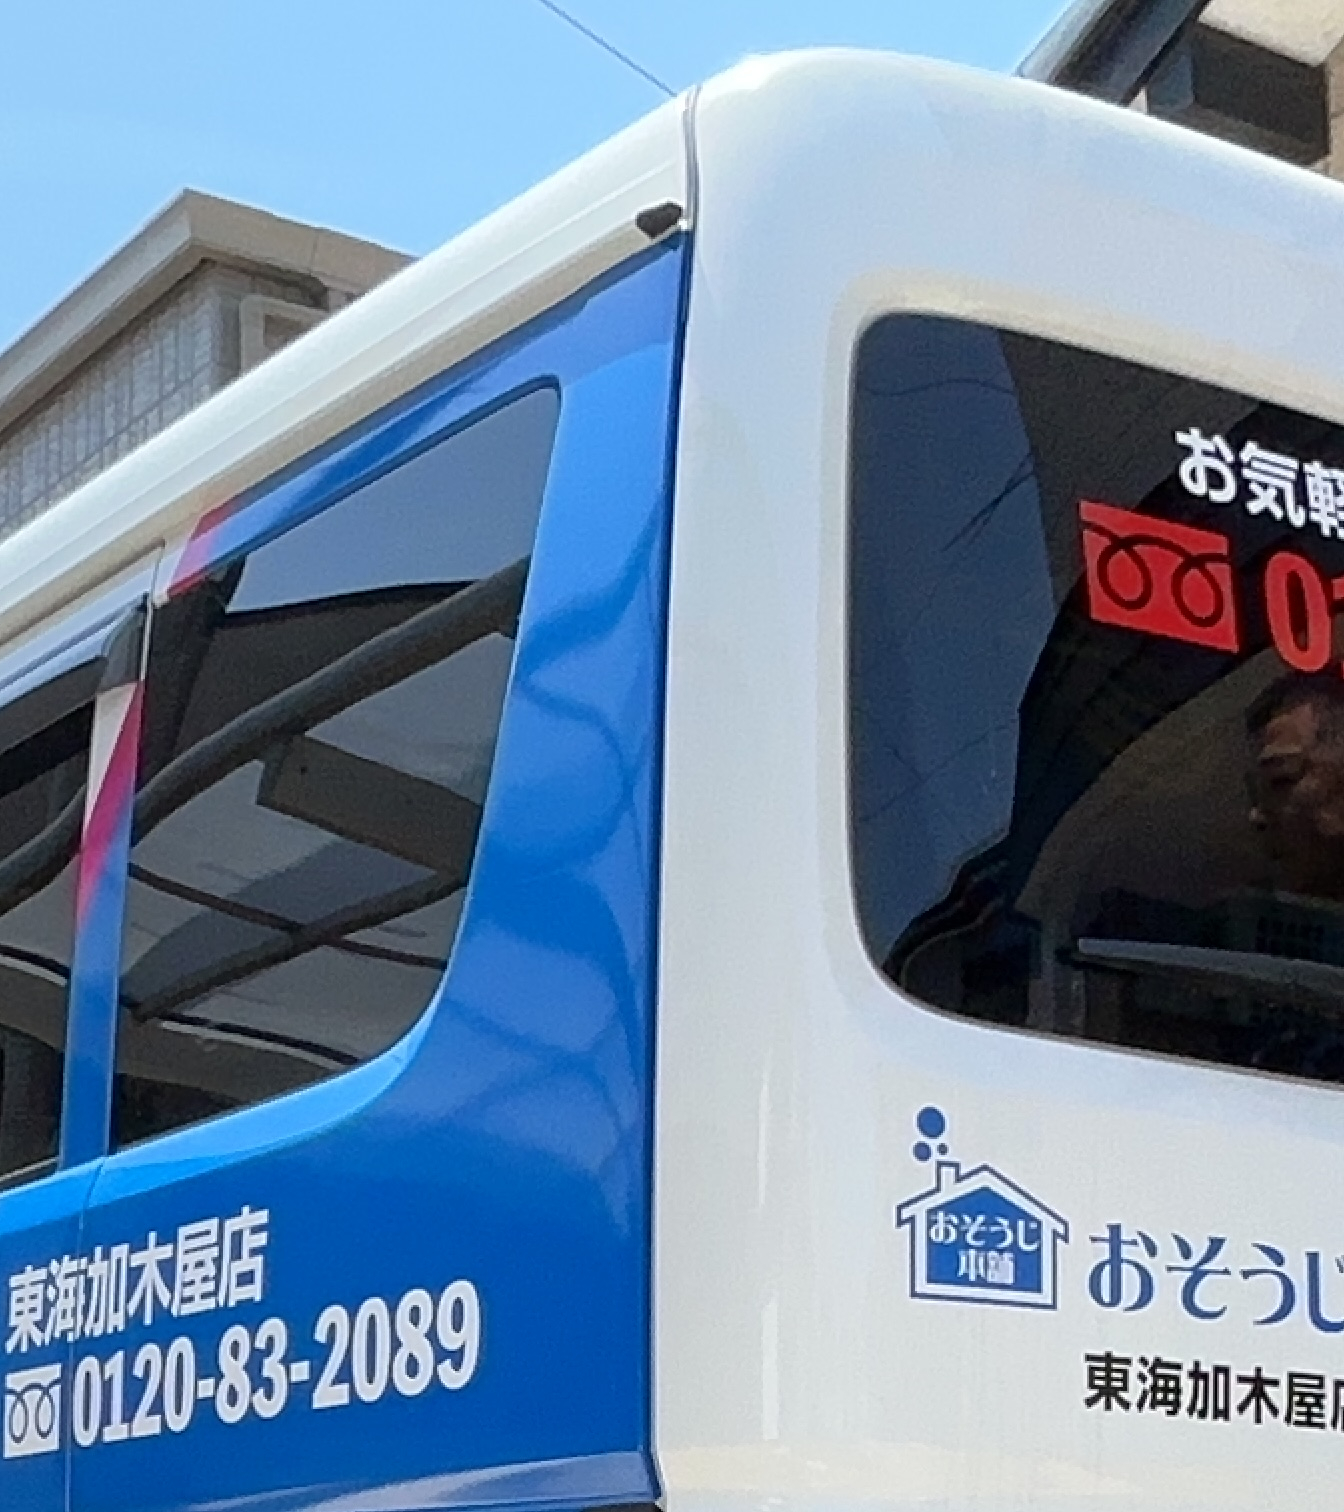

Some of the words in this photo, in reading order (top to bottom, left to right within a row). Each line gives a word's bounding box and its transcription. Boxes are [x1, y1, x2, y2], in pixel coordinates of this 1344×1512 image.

[5, 1206, 269, 1353] 東海加木屋店
[930, 1210, 1039, 1251] おそうじ
[72, 1280, 480, 1448] 0120-83-2089
